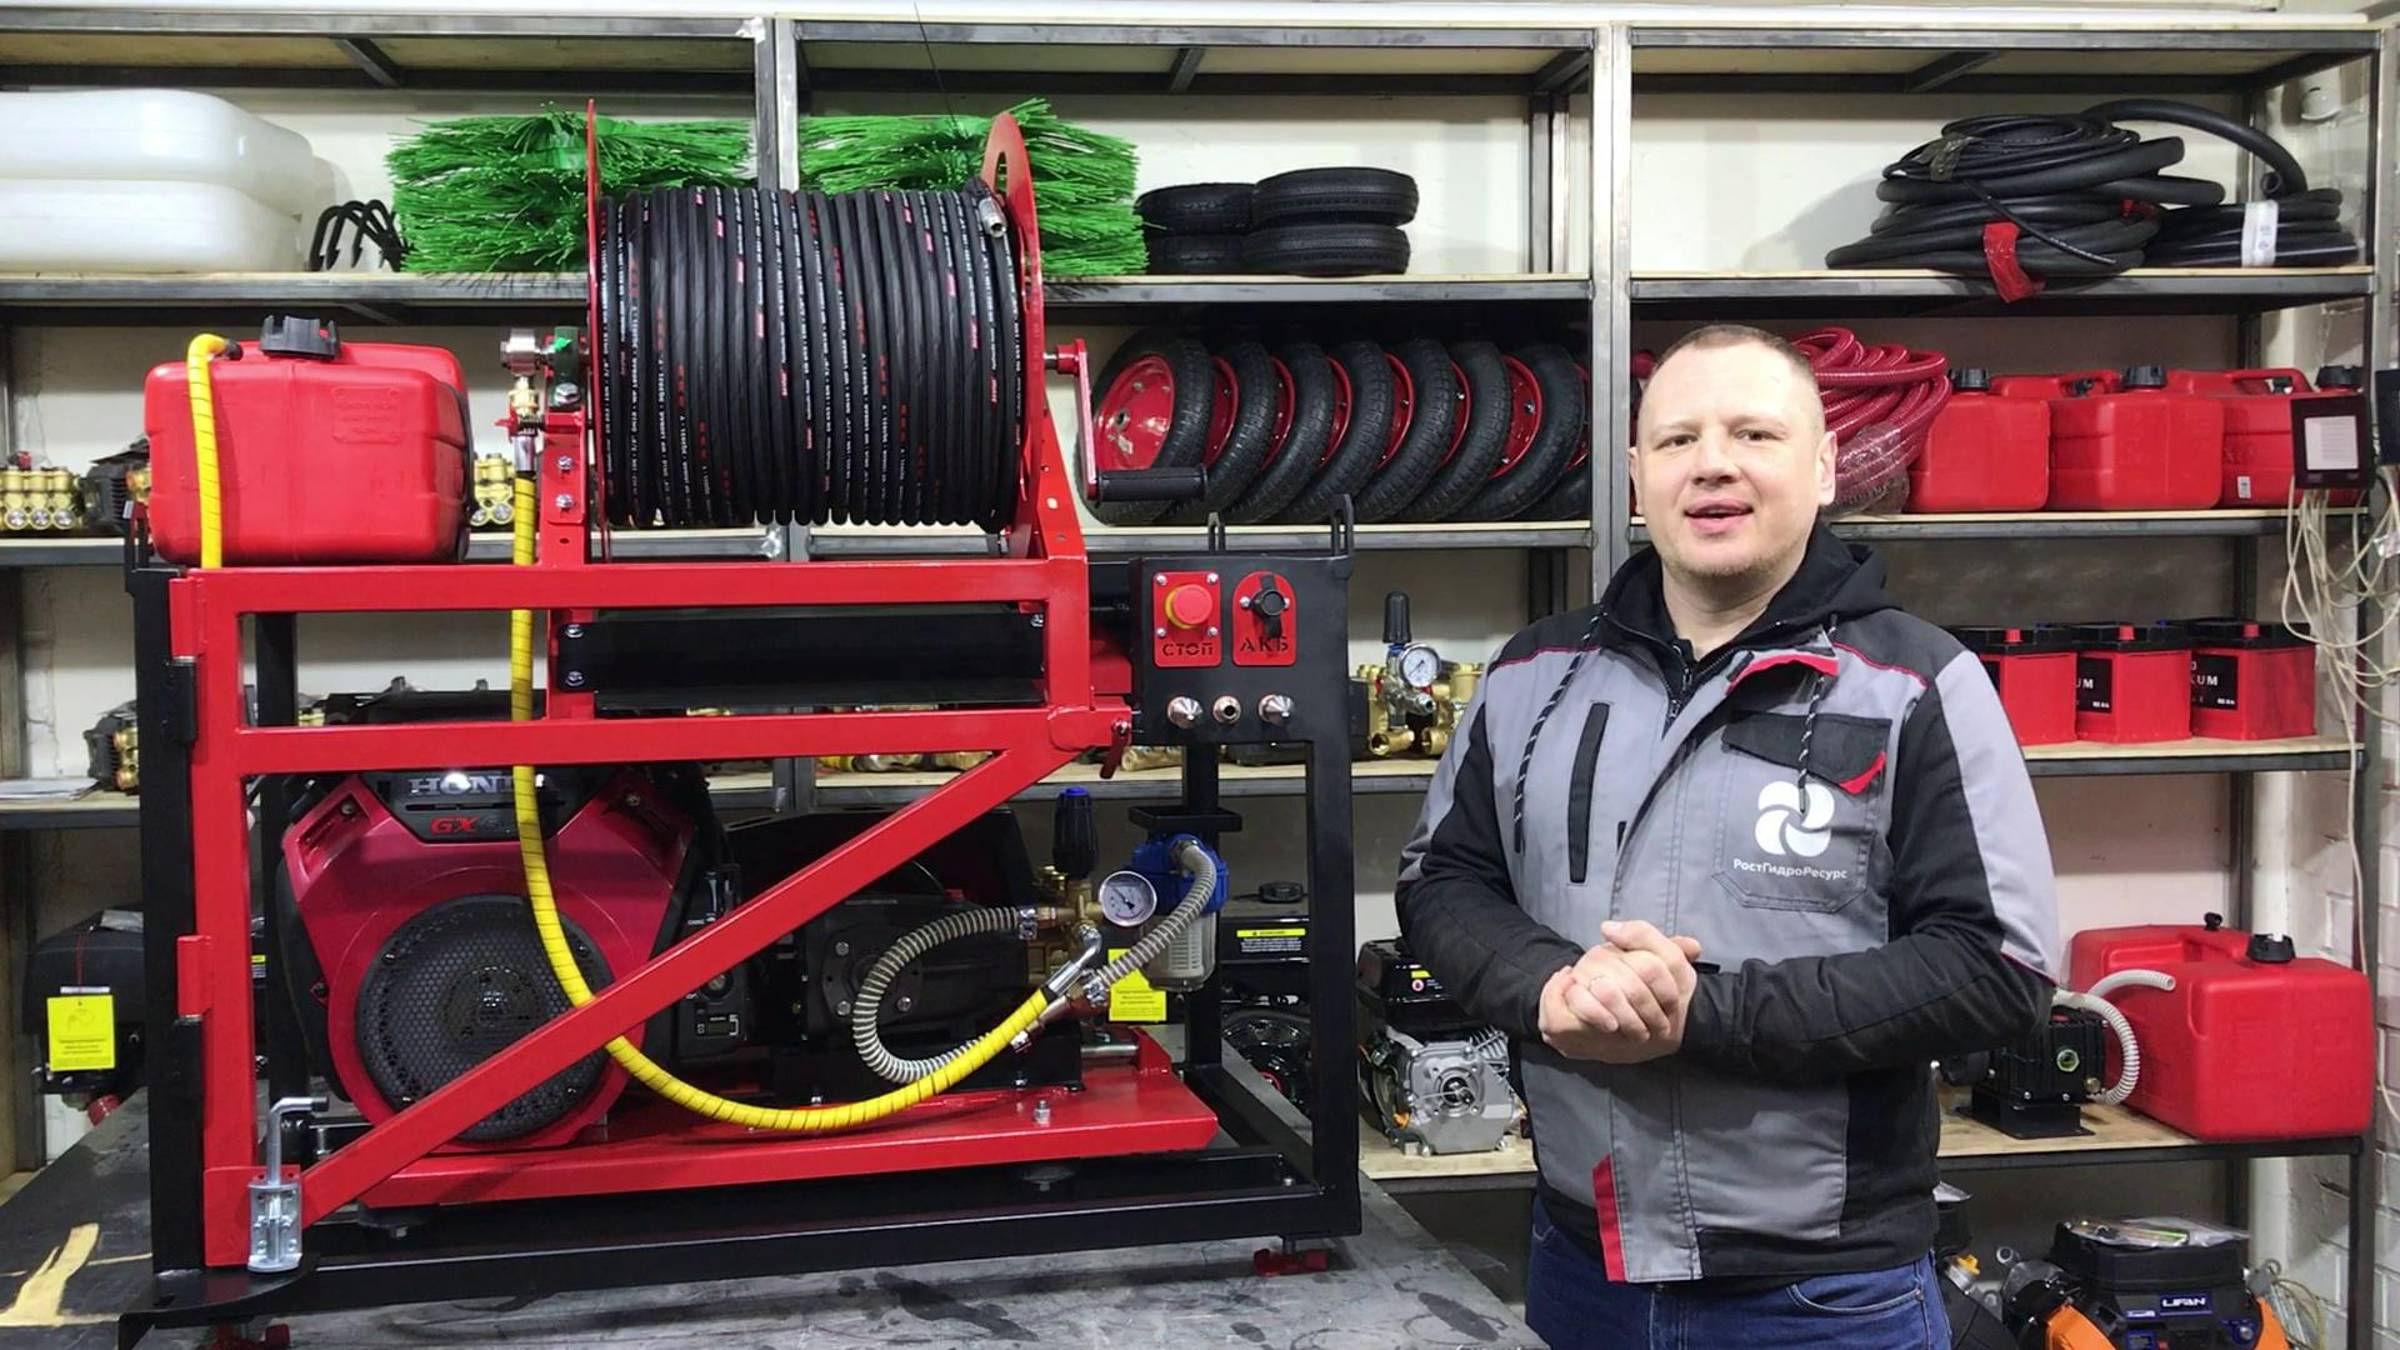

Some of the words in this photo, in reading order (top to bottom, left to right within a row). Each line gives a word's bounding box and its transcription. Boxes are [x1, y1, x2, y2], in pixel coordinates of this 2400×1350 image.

[1162, 641, 1213, 657] СТОП
[1733, 858, 1848, 881] РостГидроРесурс
[2162, 1298, 2206, 1308] LIFAN
